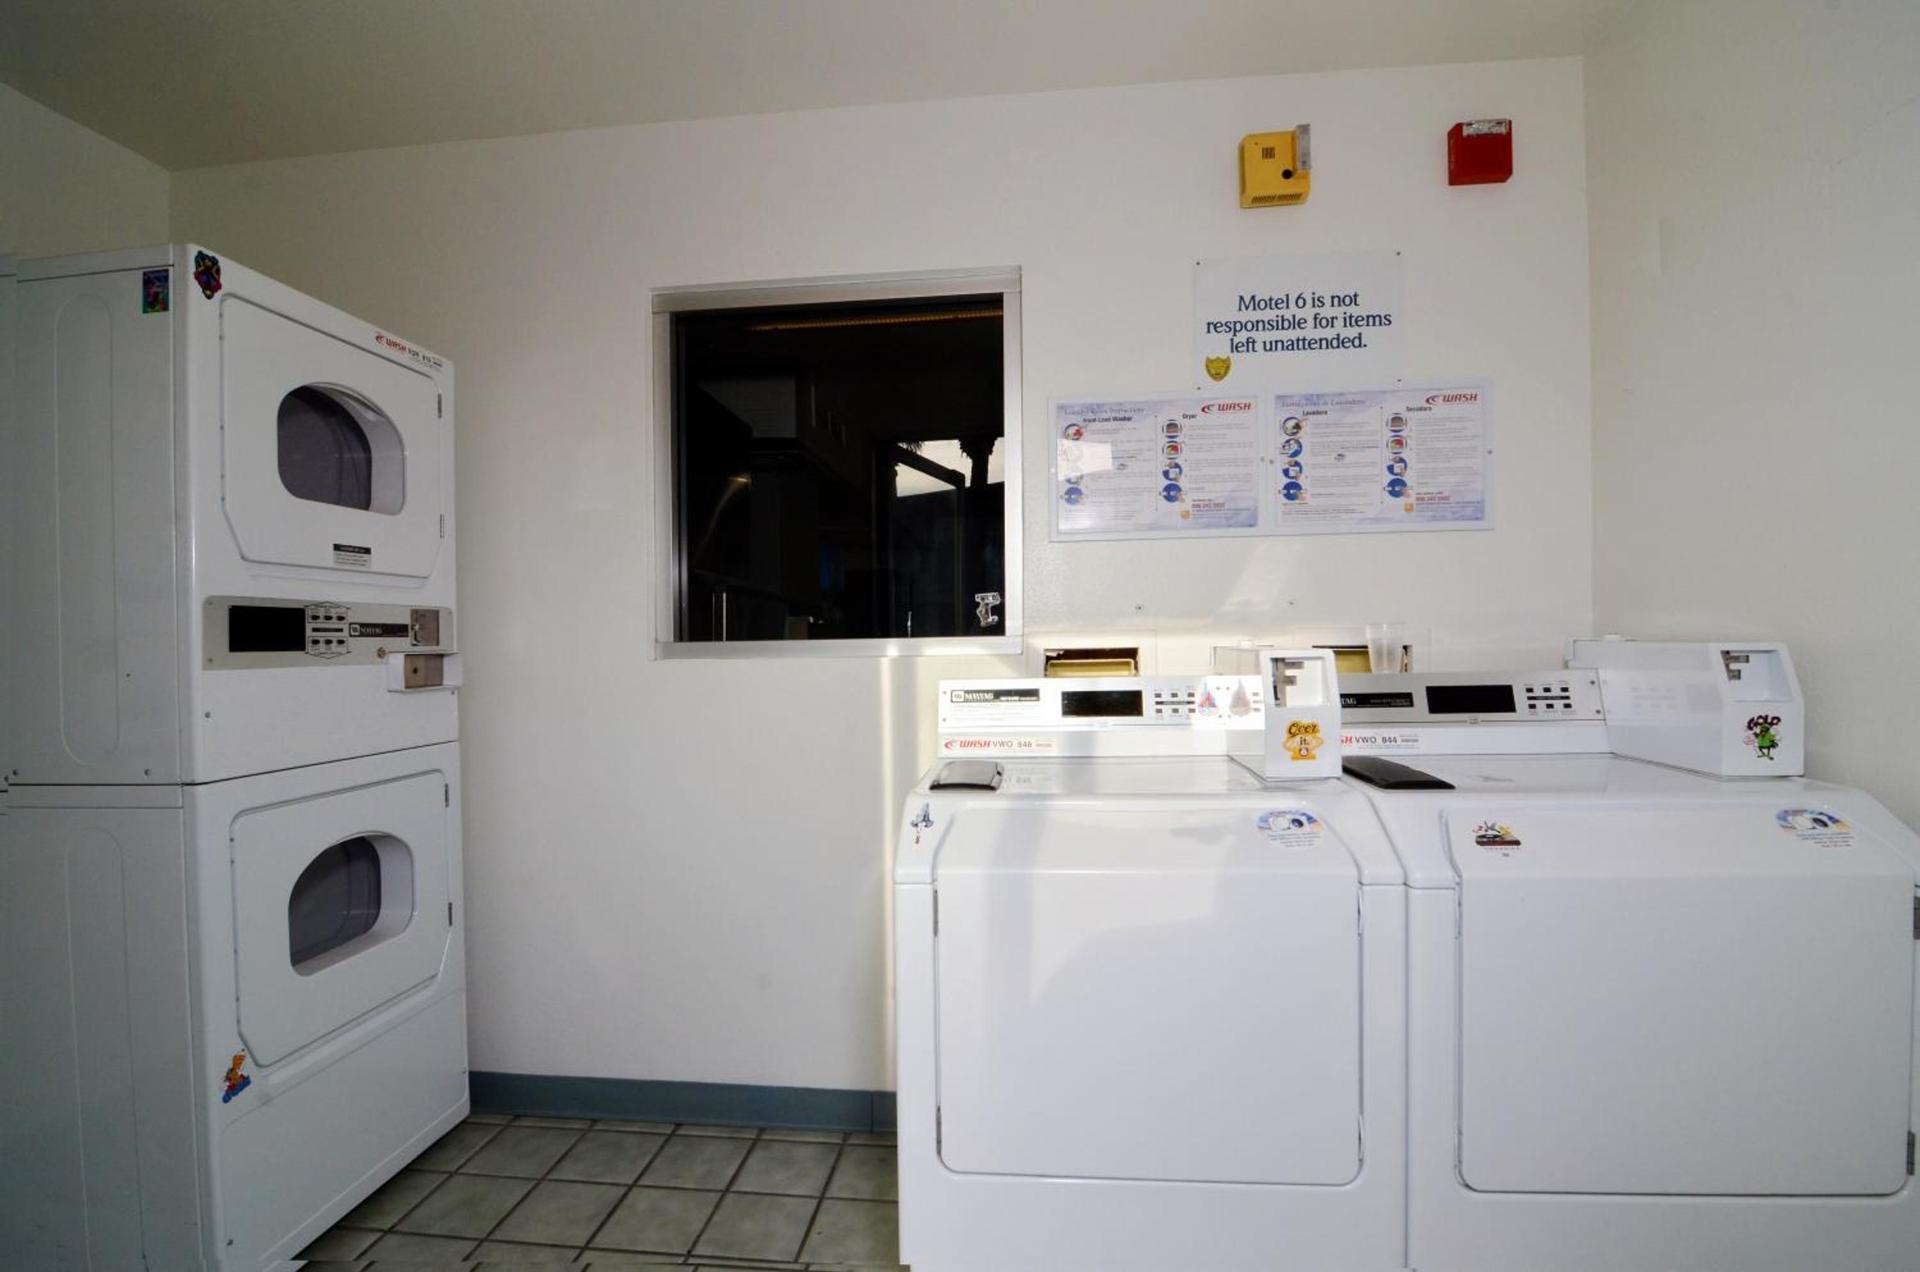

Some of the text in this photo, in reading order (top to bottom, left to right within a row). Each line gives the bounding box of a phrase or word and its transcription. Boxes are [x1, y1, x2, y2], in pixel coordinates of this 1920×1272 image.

[1237, 291, 1360, 312] Motel 6 is not
[1206, 312, 1392, 336] responsible for items
[1230, 332, 1367, 354] left unattended.
[1442, 393, 1478, 403] WASH
[1217, 402, 1252, 412] WASH
[960, 740, 992, 748] WASH
